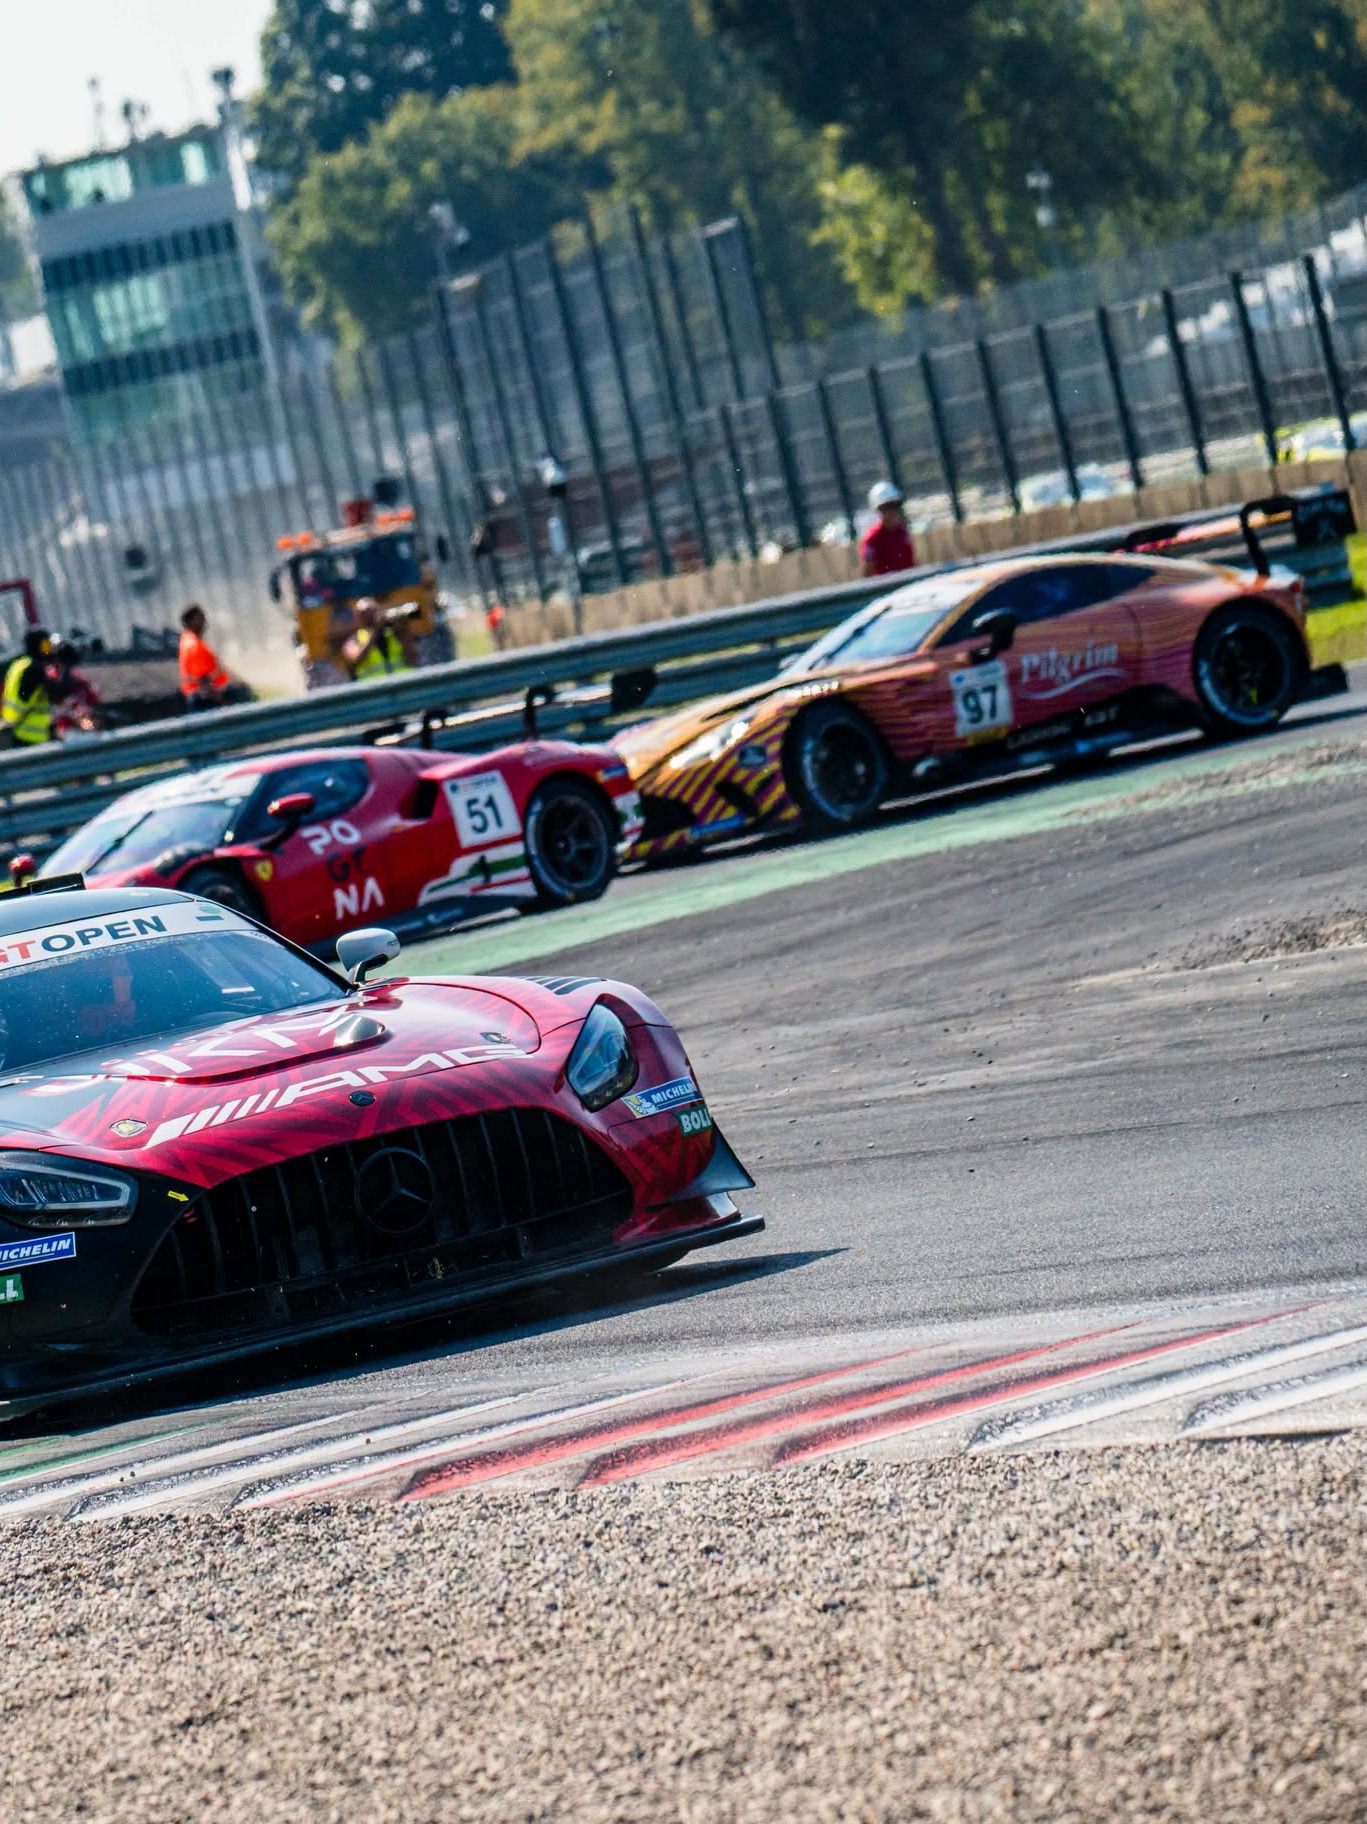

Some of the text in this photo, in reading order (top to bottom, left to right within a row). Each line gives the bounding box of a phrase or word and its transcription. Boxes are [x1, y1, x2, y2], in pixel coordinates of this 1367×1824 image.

[1021, 639, 1119, 686] Pilgrim
[962, 684, 998, 725] 97
[466, 794, 503, 834] 51
[299, 818, 362, 855] PO
